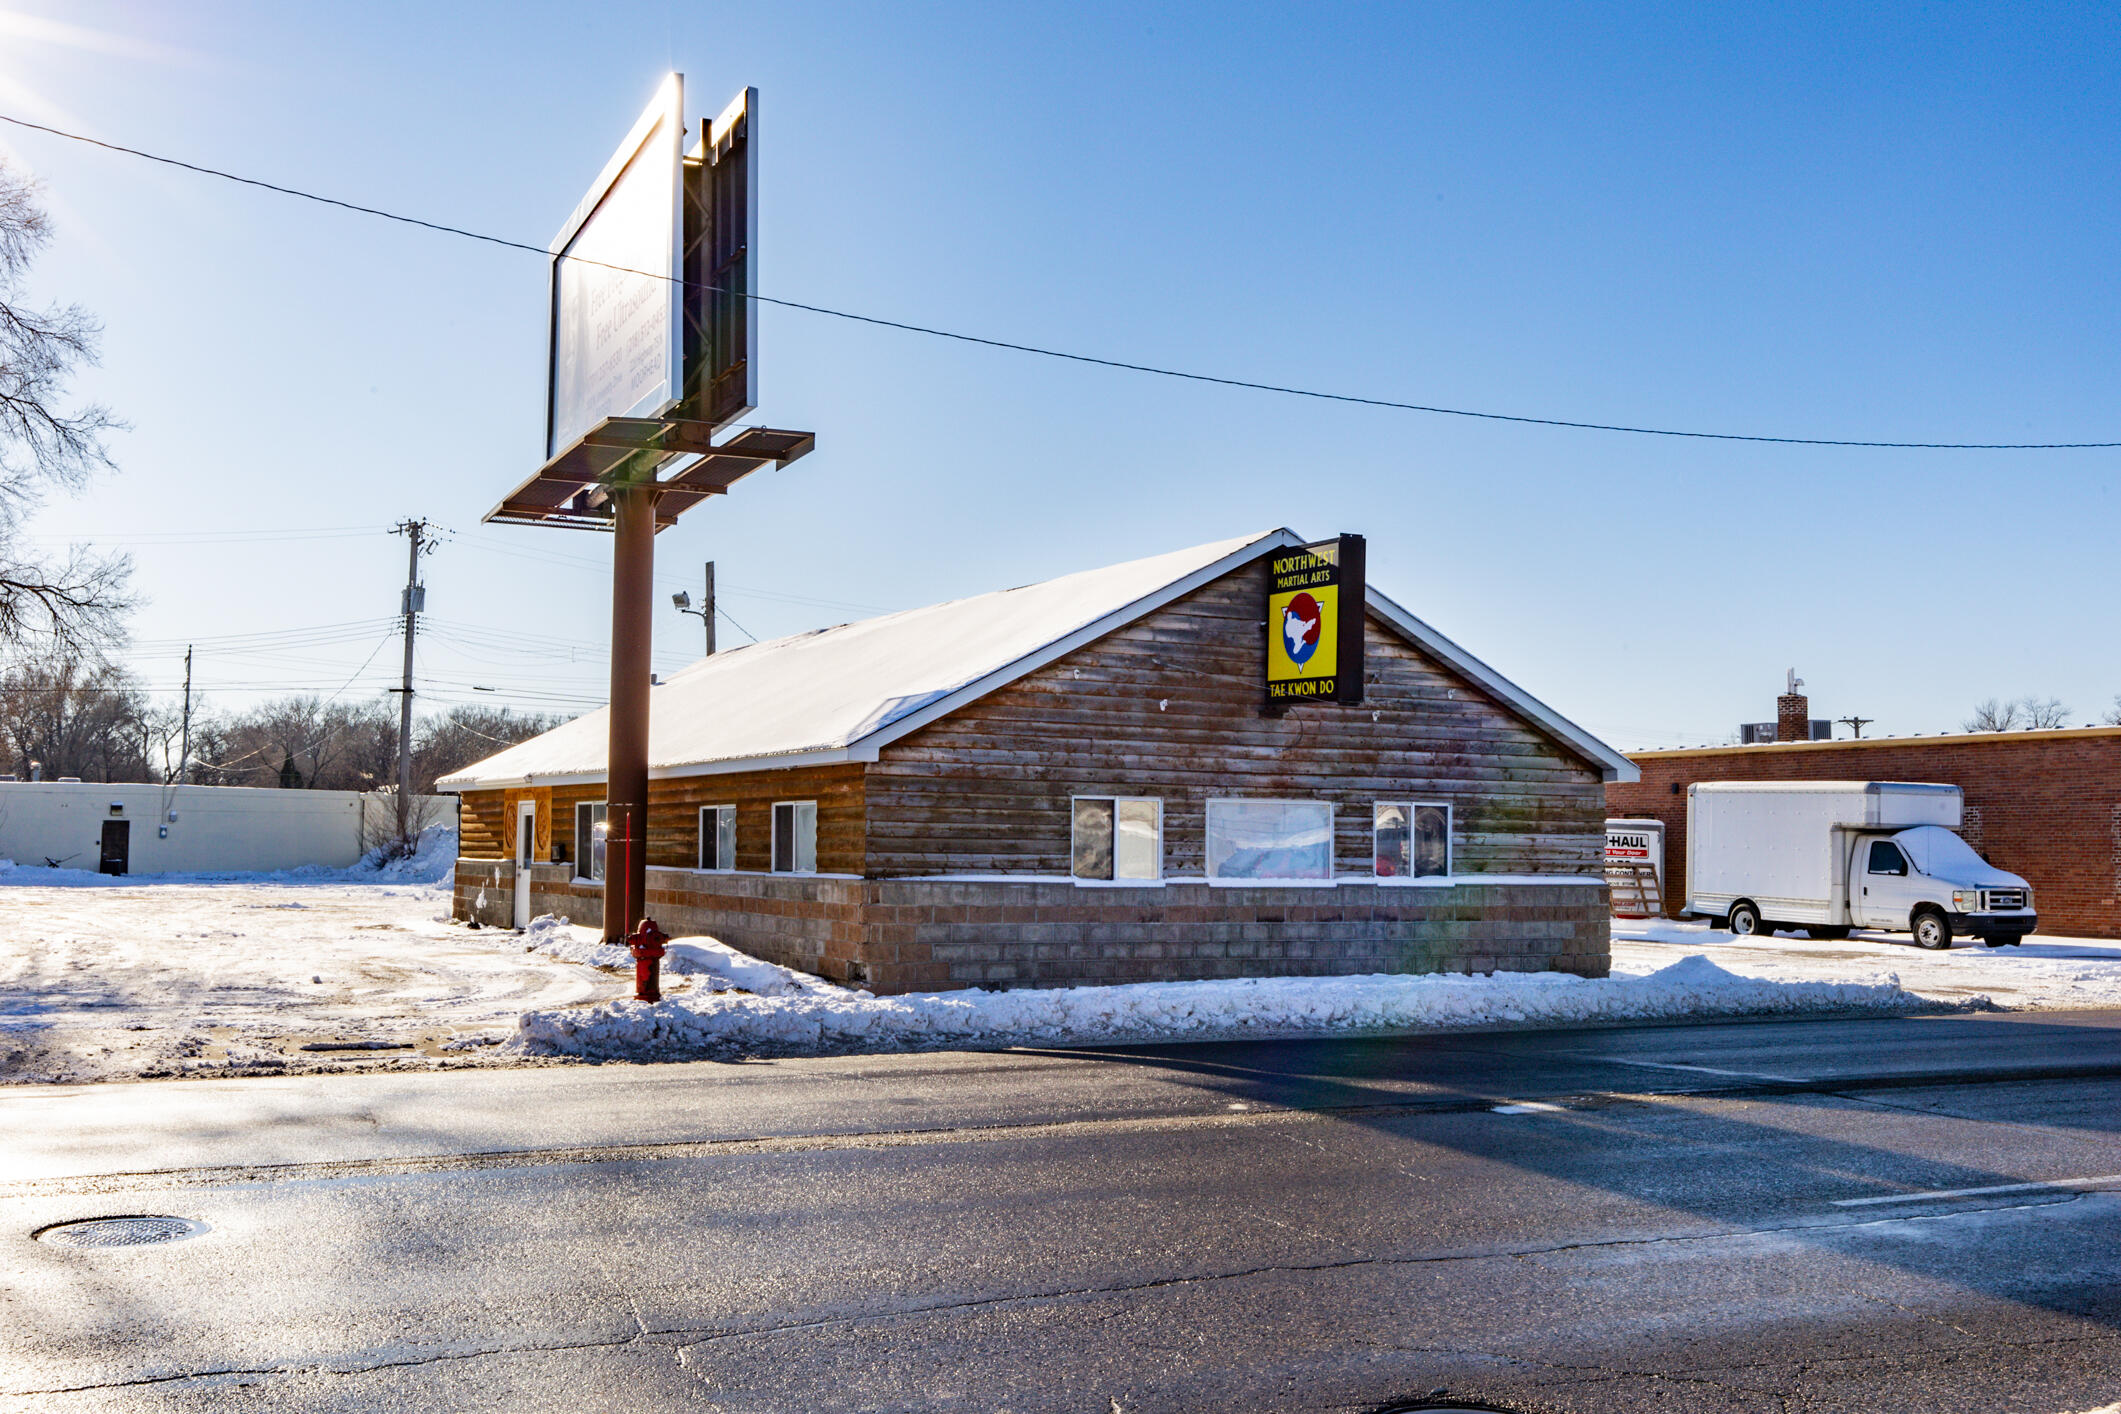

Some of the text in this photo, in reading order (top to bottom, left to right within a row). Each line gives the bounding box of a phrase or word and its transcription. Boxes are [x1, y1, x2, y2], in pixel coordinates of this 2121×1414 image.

[596, 321, 611, 350] Free
[612, 279, 656, 333] Ultrasound
[1273, 549, 1336, 575] NORTHWEST
[1277, 570, 1330, 589] MARTIAL ARTS
[1270, 679, 1334, 697] TAE KWON DO
